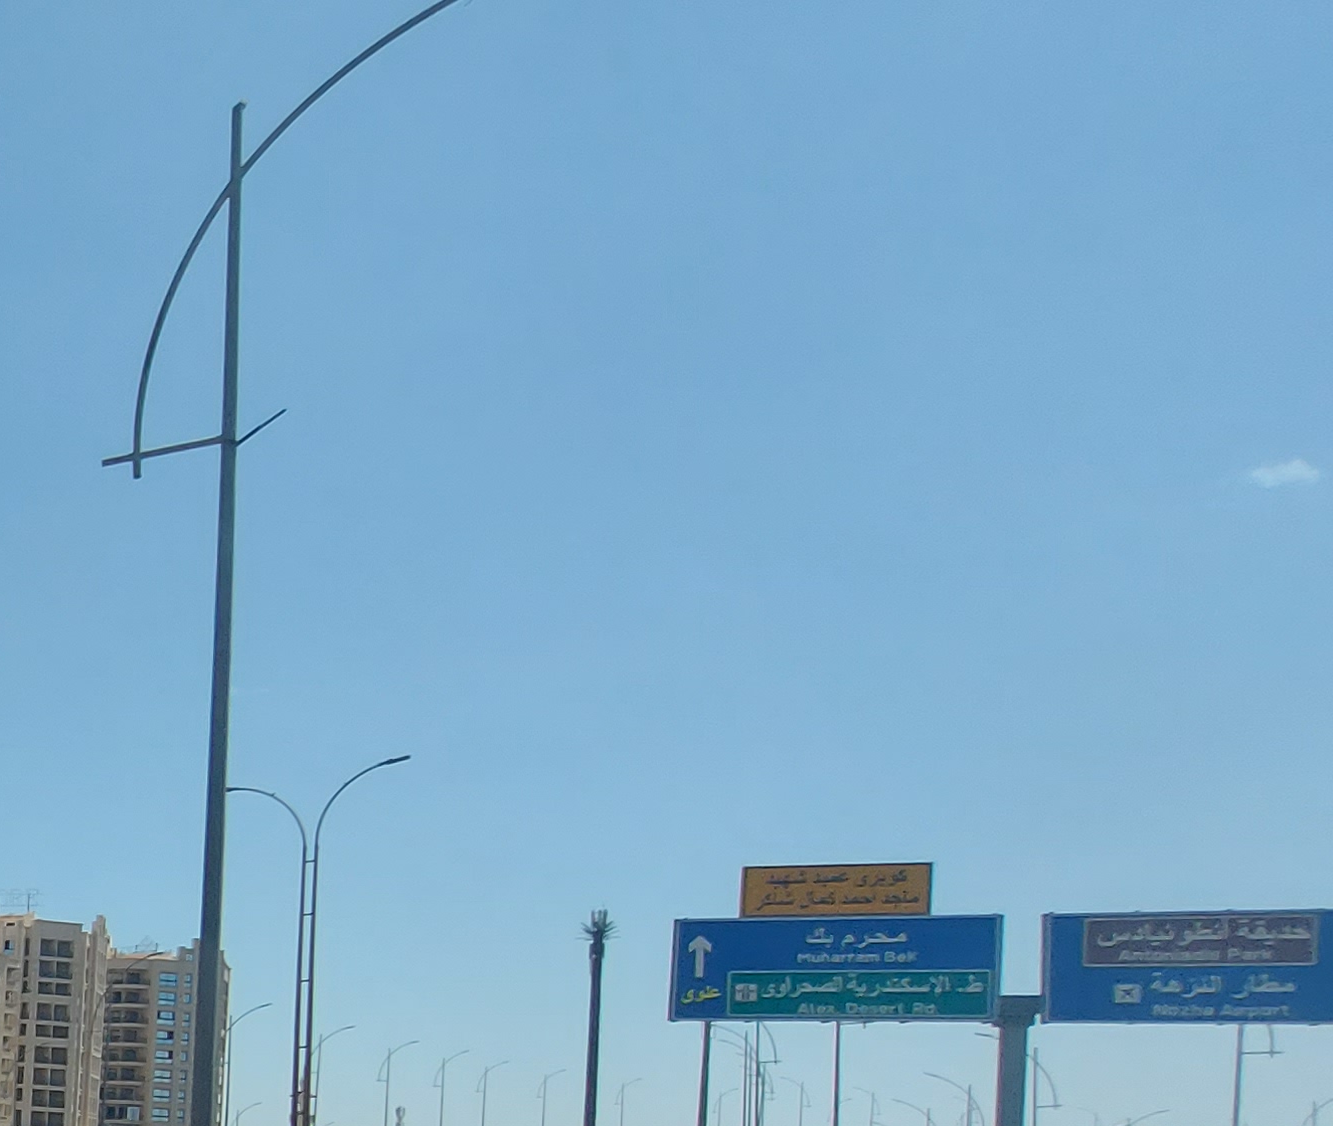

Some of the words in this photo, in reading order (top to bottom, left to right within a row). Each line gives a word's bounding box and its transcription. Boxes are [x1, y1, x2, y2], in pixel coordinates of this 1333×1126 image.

[805, 928, 834, 948] بك
[840, 930, 908, 949] محرم
[1235, 919, 1312, 945] حديقة
[797, 951, 881, 964] Muharram
[1228, 948, 1273, 960] Park
[1149, 972, 1222, 998] النزهة
[1230, 974, 1296, 999] مطار
[846, 1003, 904, 1015] Desert
[1219, 1004, 1290, 1017] Airport
